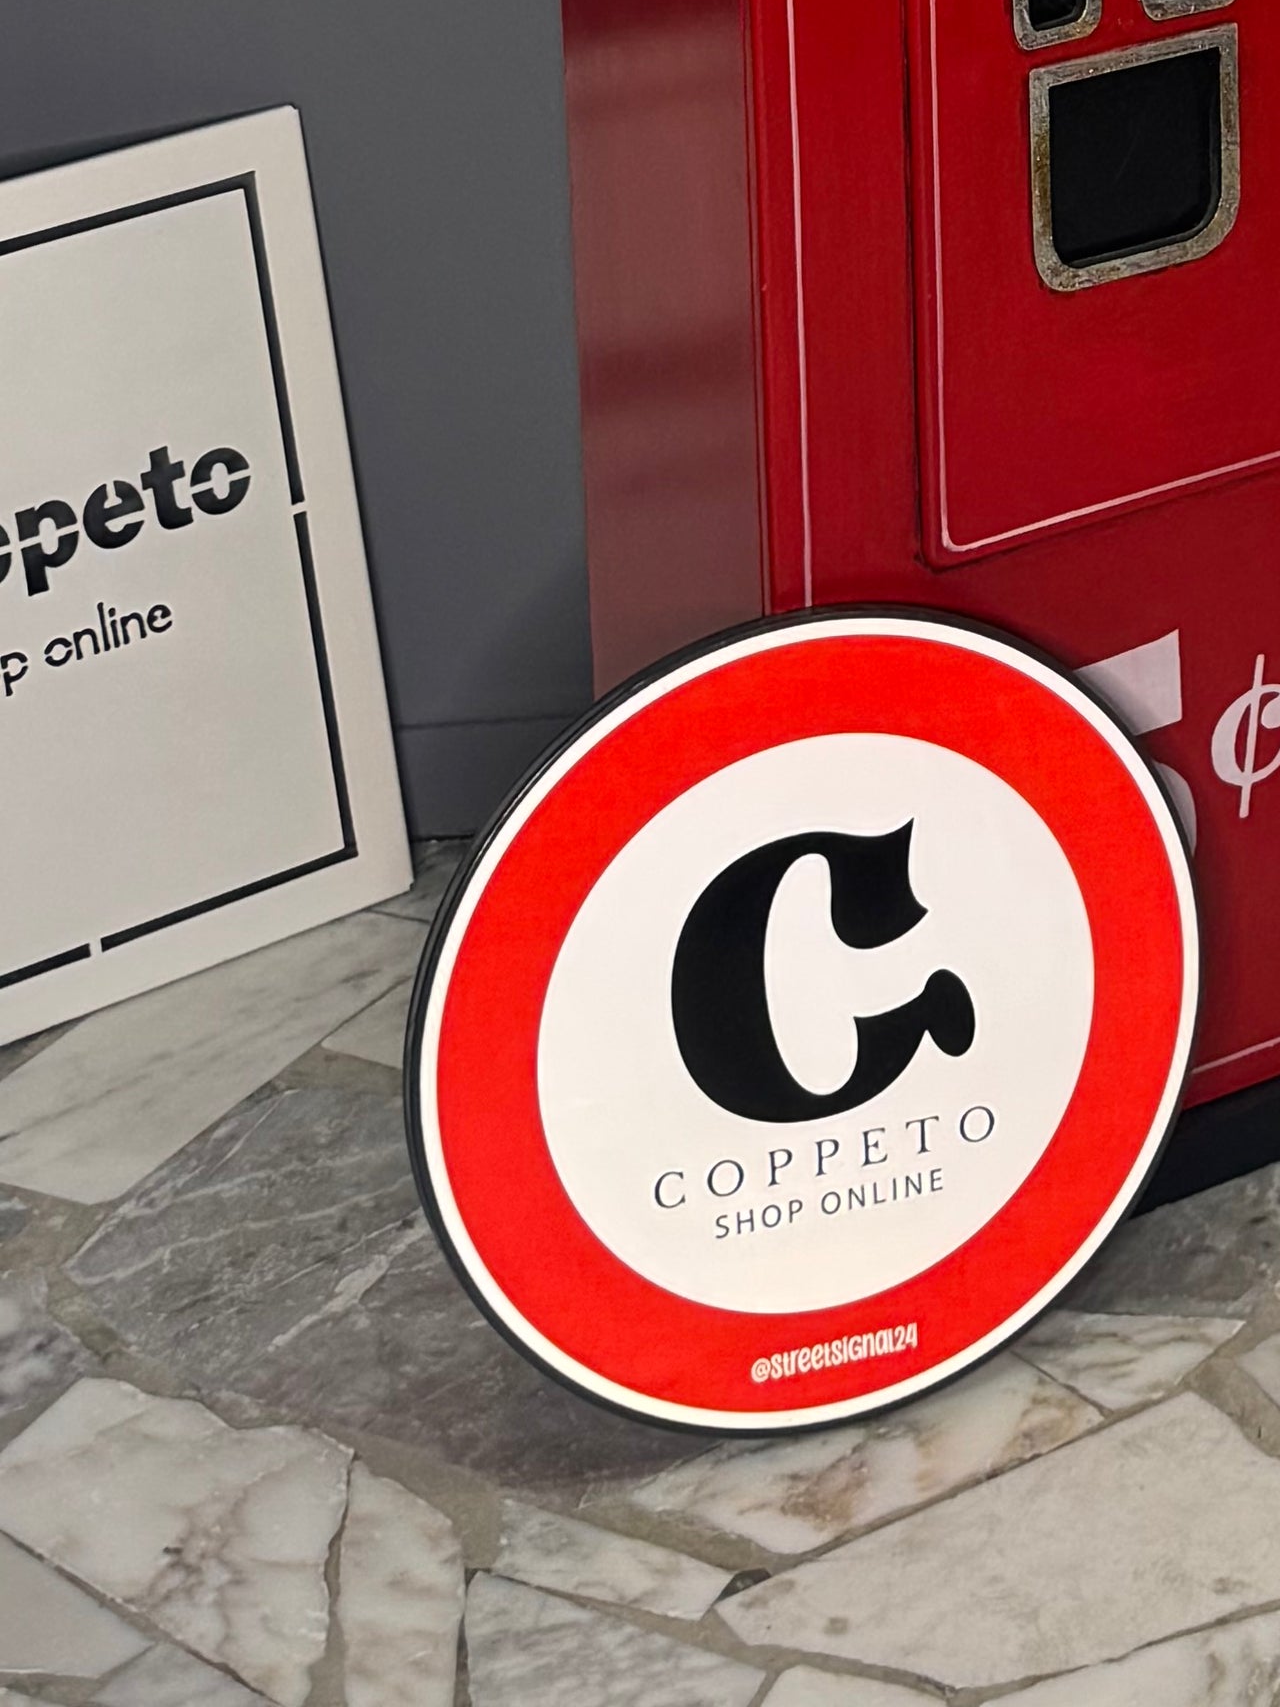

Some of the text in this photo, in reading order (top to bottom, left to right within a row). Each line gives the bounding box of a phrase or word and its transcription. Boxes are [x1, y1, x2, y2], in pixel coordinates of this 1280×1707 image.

[0, 445, 252, 597] peto
[43, 601, 173, 667] online
[653, 1105, 996, 1209] COPPETO
[714, 1168, 944, 1239] SHOP ONLINE
